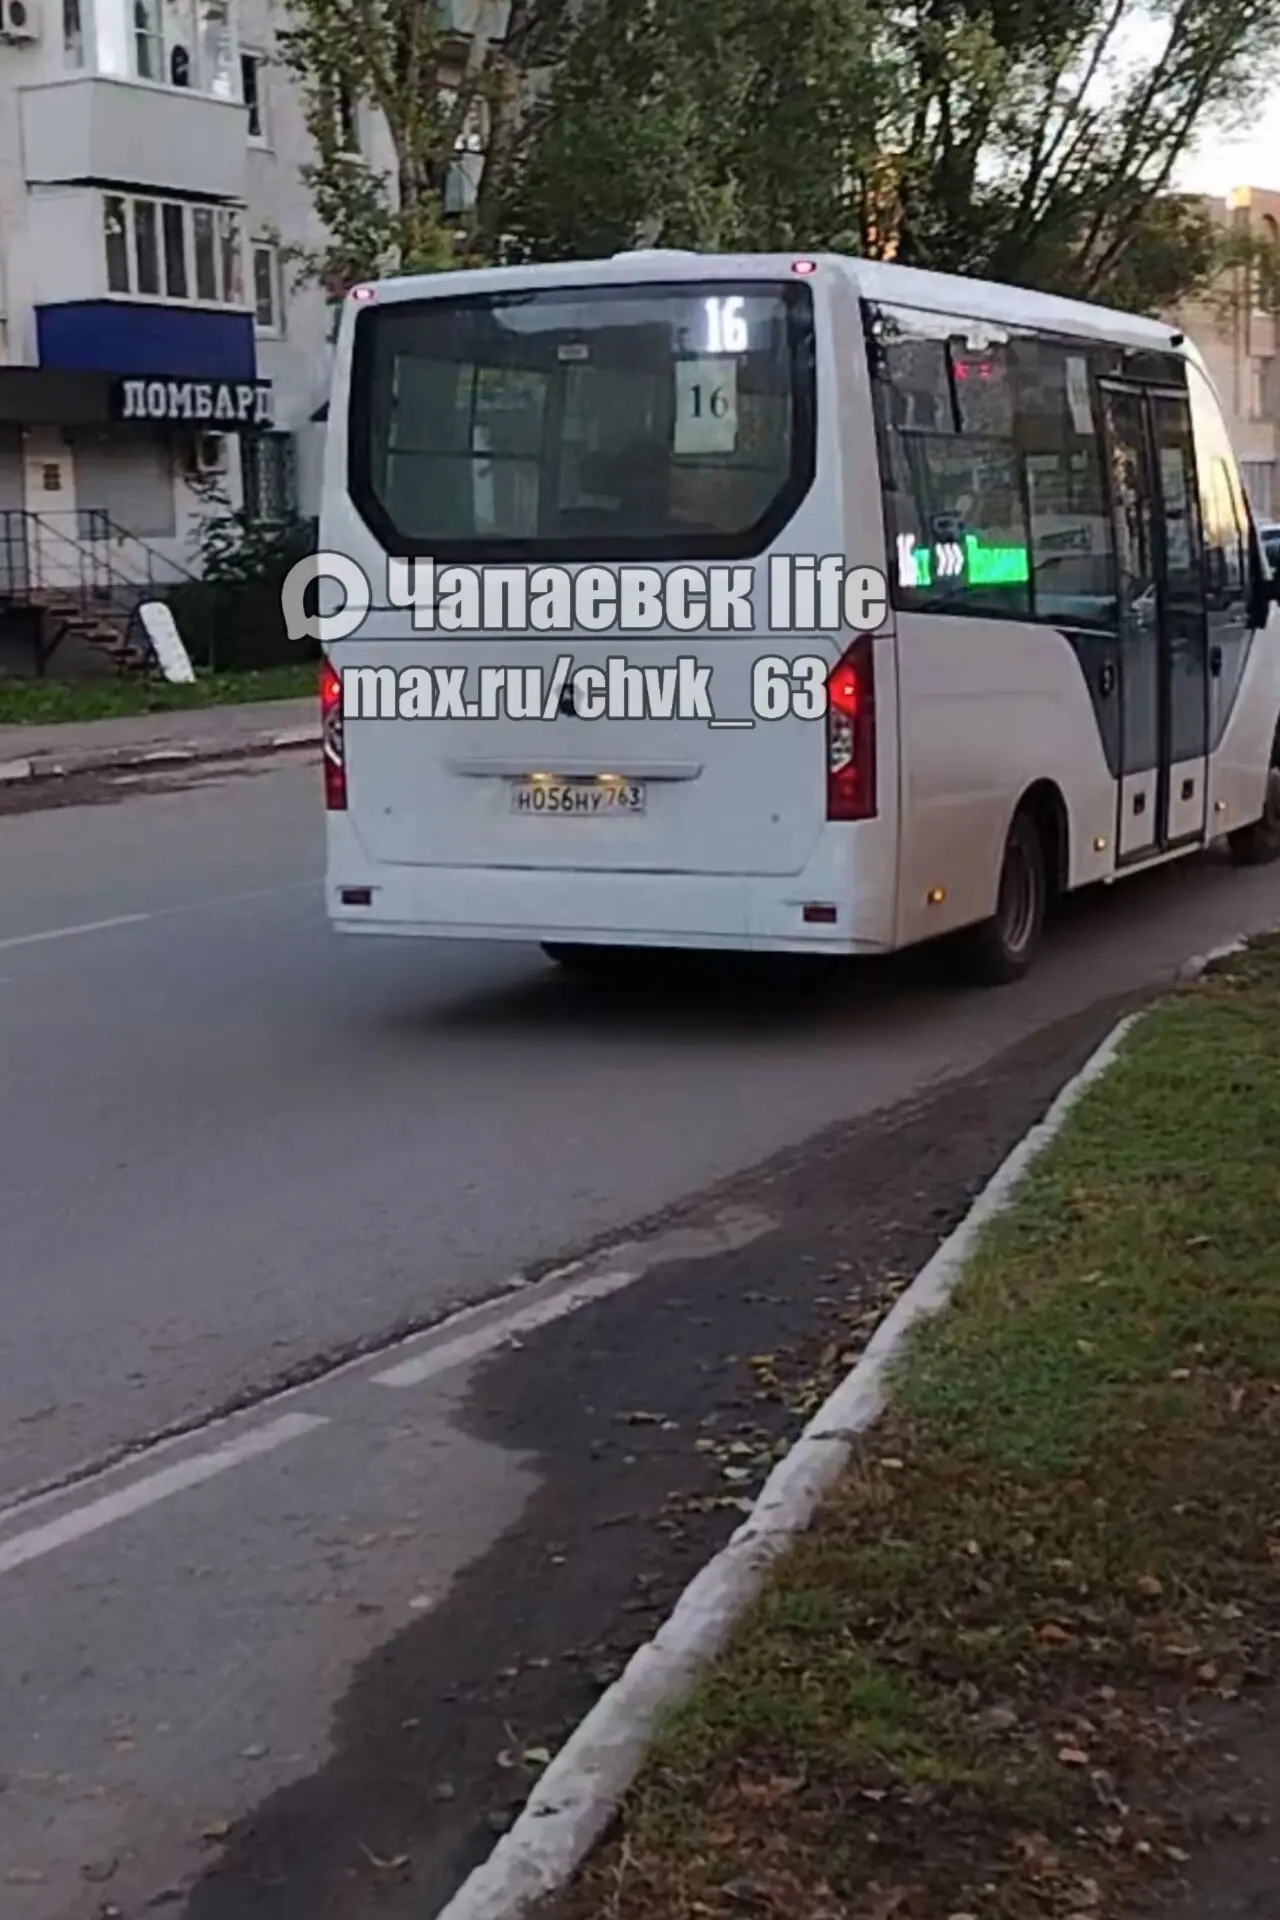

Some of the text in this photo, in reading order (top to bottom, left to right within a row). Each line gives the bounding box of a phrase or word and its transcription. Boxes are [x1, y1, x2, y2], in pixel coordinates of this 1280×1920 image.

[705, 296, 748, 353] 16
[123, 380, 274, 425] ЛОМБАРД
[689, 384, 729, 418] 16
